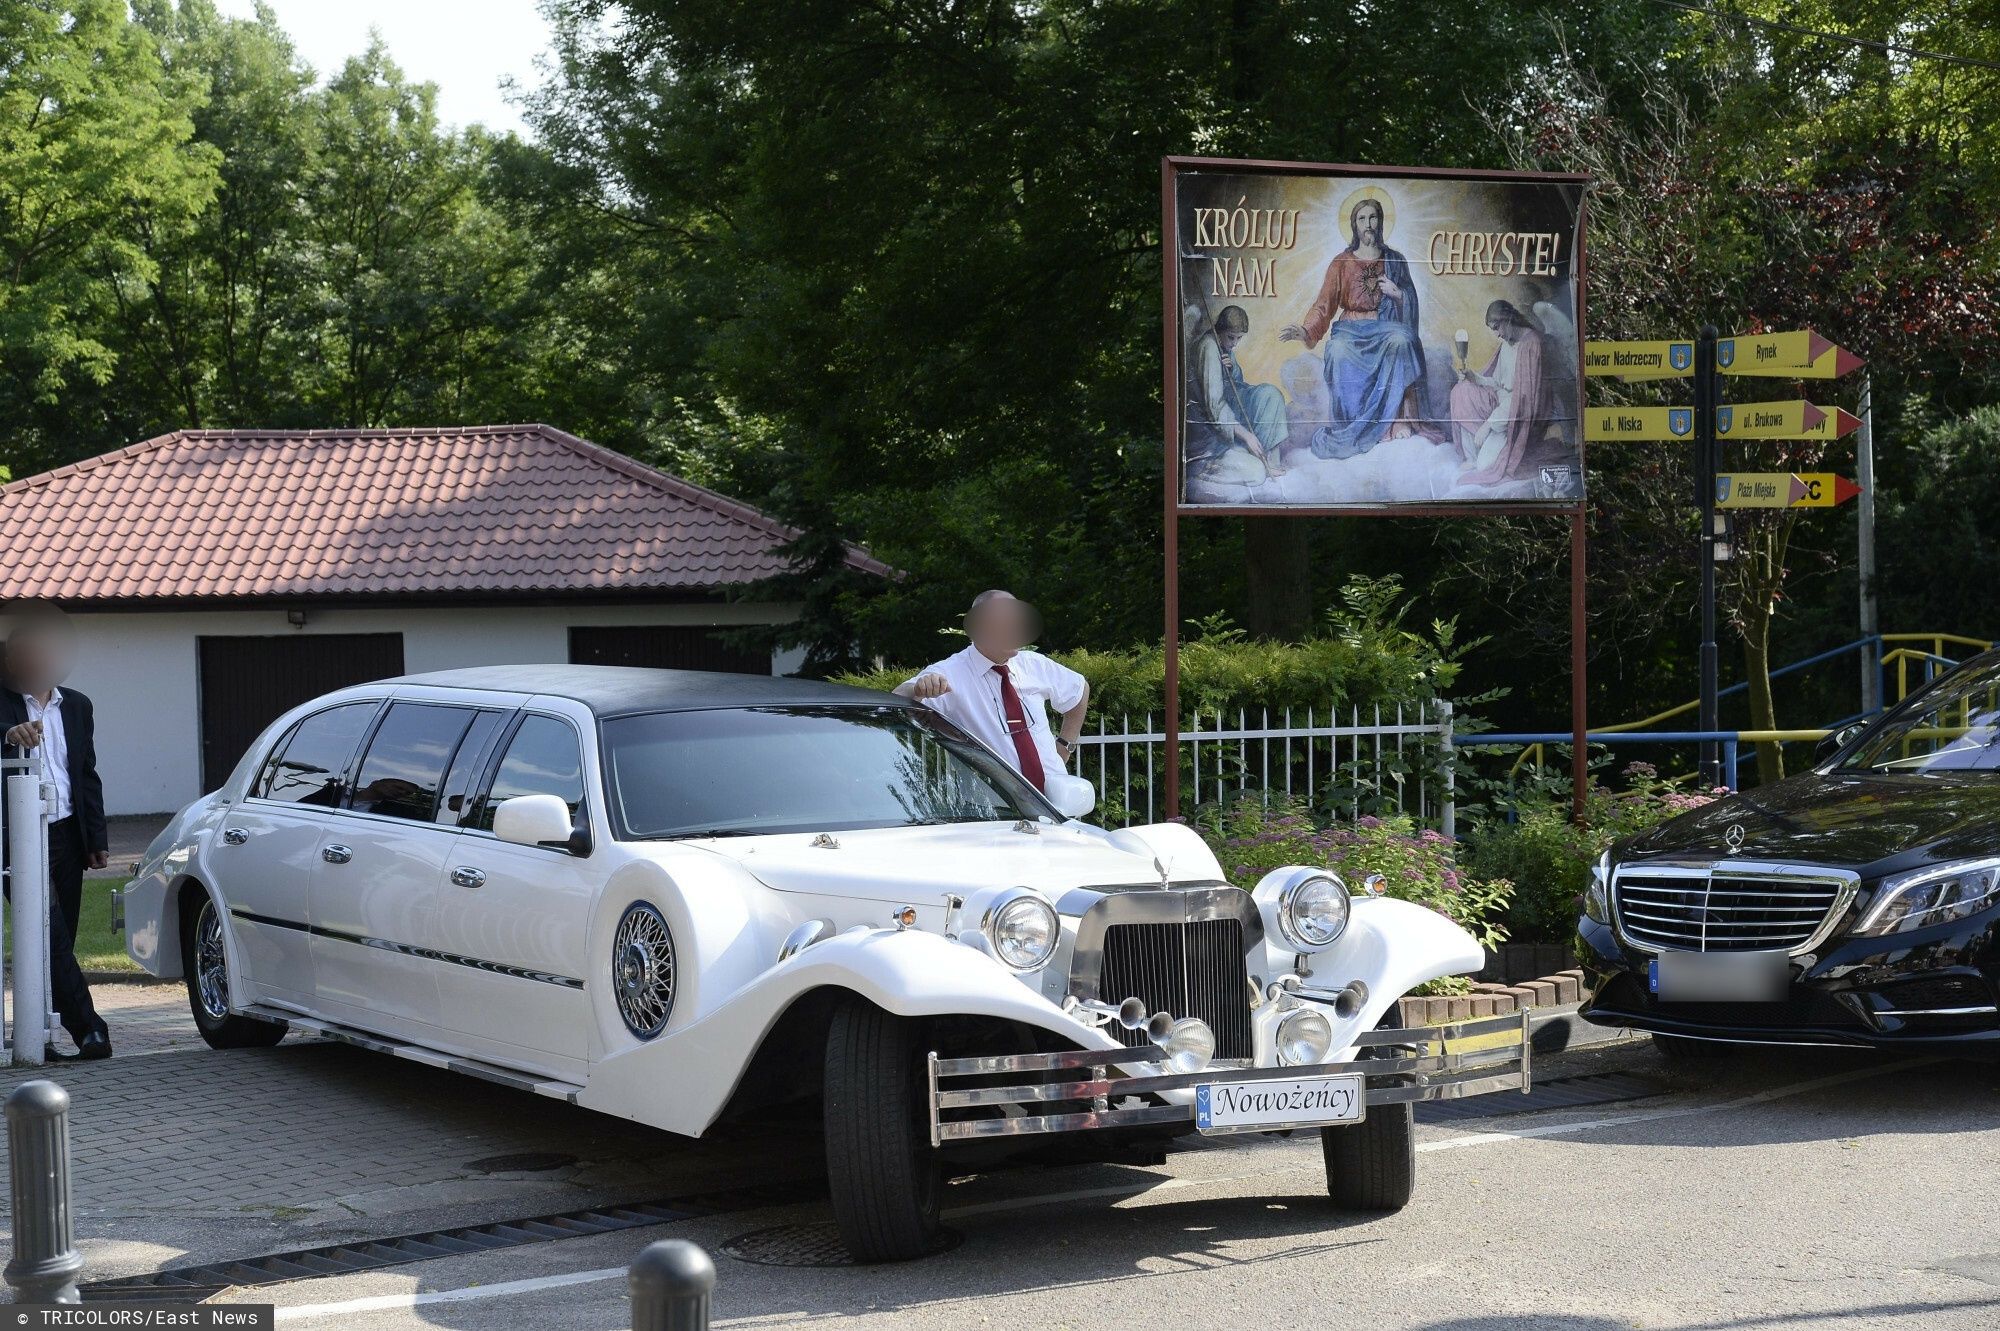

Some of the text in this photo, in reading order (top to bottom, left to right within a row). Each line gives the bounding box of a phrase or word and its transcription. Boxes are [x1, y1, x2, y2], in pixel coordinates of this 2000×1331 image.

[1193, 195, 1299, 252] KRÓLUJ
[1428, 230, 1561, 278] CHRYSTE!
[1211, 257, 1277, 299] NAM
[1585, 351, 1663, 368] ulwar Nadrzeczny
[1756, 344, 1777, 361] Rynek
[1602, 416, 1642, 431] ul. Niska
[1743, 412, 1783, 428] ul. Brukowa
[1754, 481, 1777, 500] Miejska
[1199, 1082, 1355, 1122] PL Nowożeńcy
